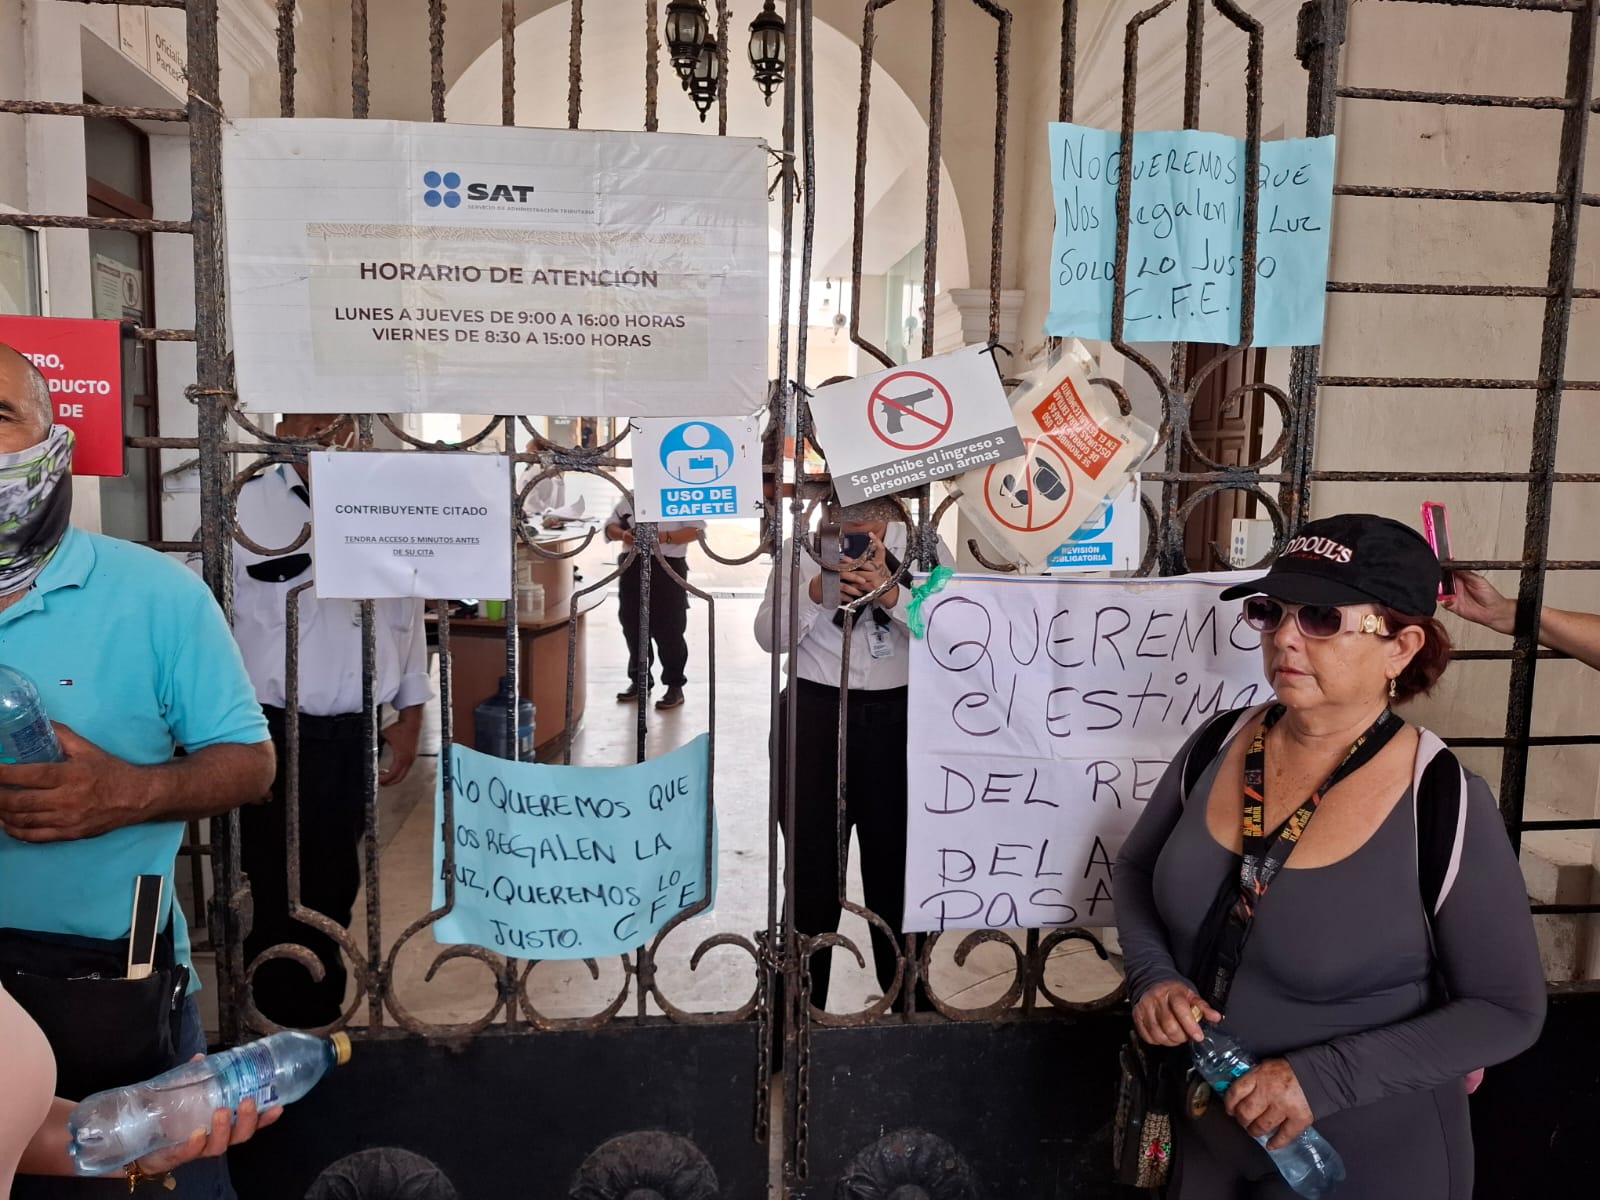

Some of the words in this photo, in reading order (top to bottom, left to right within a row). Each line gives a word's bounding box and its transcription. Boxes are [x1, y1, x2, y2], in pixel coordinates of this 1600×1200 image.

[467, 183, 535, 203] SAT
[1191, 238, 1277, 279] JUSO
[359, 261, 482, 283] HORARIO
[489, 267, 523, 284] DE
[531, 265, 659, 288] ATENCIÓN
[335, 307, 395, 321] LUNES
[399, 308, 413, 321] A
[416, 308, 485, 324] JUEVES
[490, 310, 514, 325] DE
[518, 311, 557, 326] 9:00
[560, 312, 574, 326] A
[577, 312, 620, 327] 16:00
[625, 313, 686, 329] HORAS
[372, 328, 449, 342] VIERNES
[455, 329, 479, 343] DE
[485, 330, 521, 345] 8:30
[526, 331, 540, 345] A
[543, 332, 586, 346] 15:00
[591, 333, 651, 348] HORAS
[59, 403, 84, 418] DE
[1048, 402, 1063, 425] GAFAS
[1080, 431, 1112, 458] OSCURAS
[1098, 434, 1107, 443] EL
[1105, 440, 1118, 450] EN
[851, 473, 869, 487] Se
[870, 459, 924, 484] prohibe
[926, 453, 940, 466] el
[941, 438, 993, 463] ingreso
[995, 435, 1005, 446] a
[1081, 457, 1092, 468] SE
[1089, 452, 1100, 463] DE
[863, 470, 927, 498] personas
[929, 462, 955, 477] con
[956, 449, 1001, 470] armas
[667, 490, 704, 502] USO
[709, 488, 733, 500] DE
[335, 504, 439, 516] CONTRIBUYENTE
[443, 506, 488, 516] CITADO
[665, 501, 735, 516] GAFETE
[1231, 556, 1246, 566] SAT
[488, 776, 632, 819] QUEREMOS
[649, 774, 689, 811] QUE
[924, 765, 1060, 815] DEL
[441, 822, 480, 849] OS
[487, 827, 617, 868] REGALEN
[635, 832, 672, 861] LA
[937, 838, 1063, 888] DEL
[493, 875, 641, 907] QUEREMOS
[658, 869, 681, 890] LO
[490, 918, 583, 950] JUSTO.
